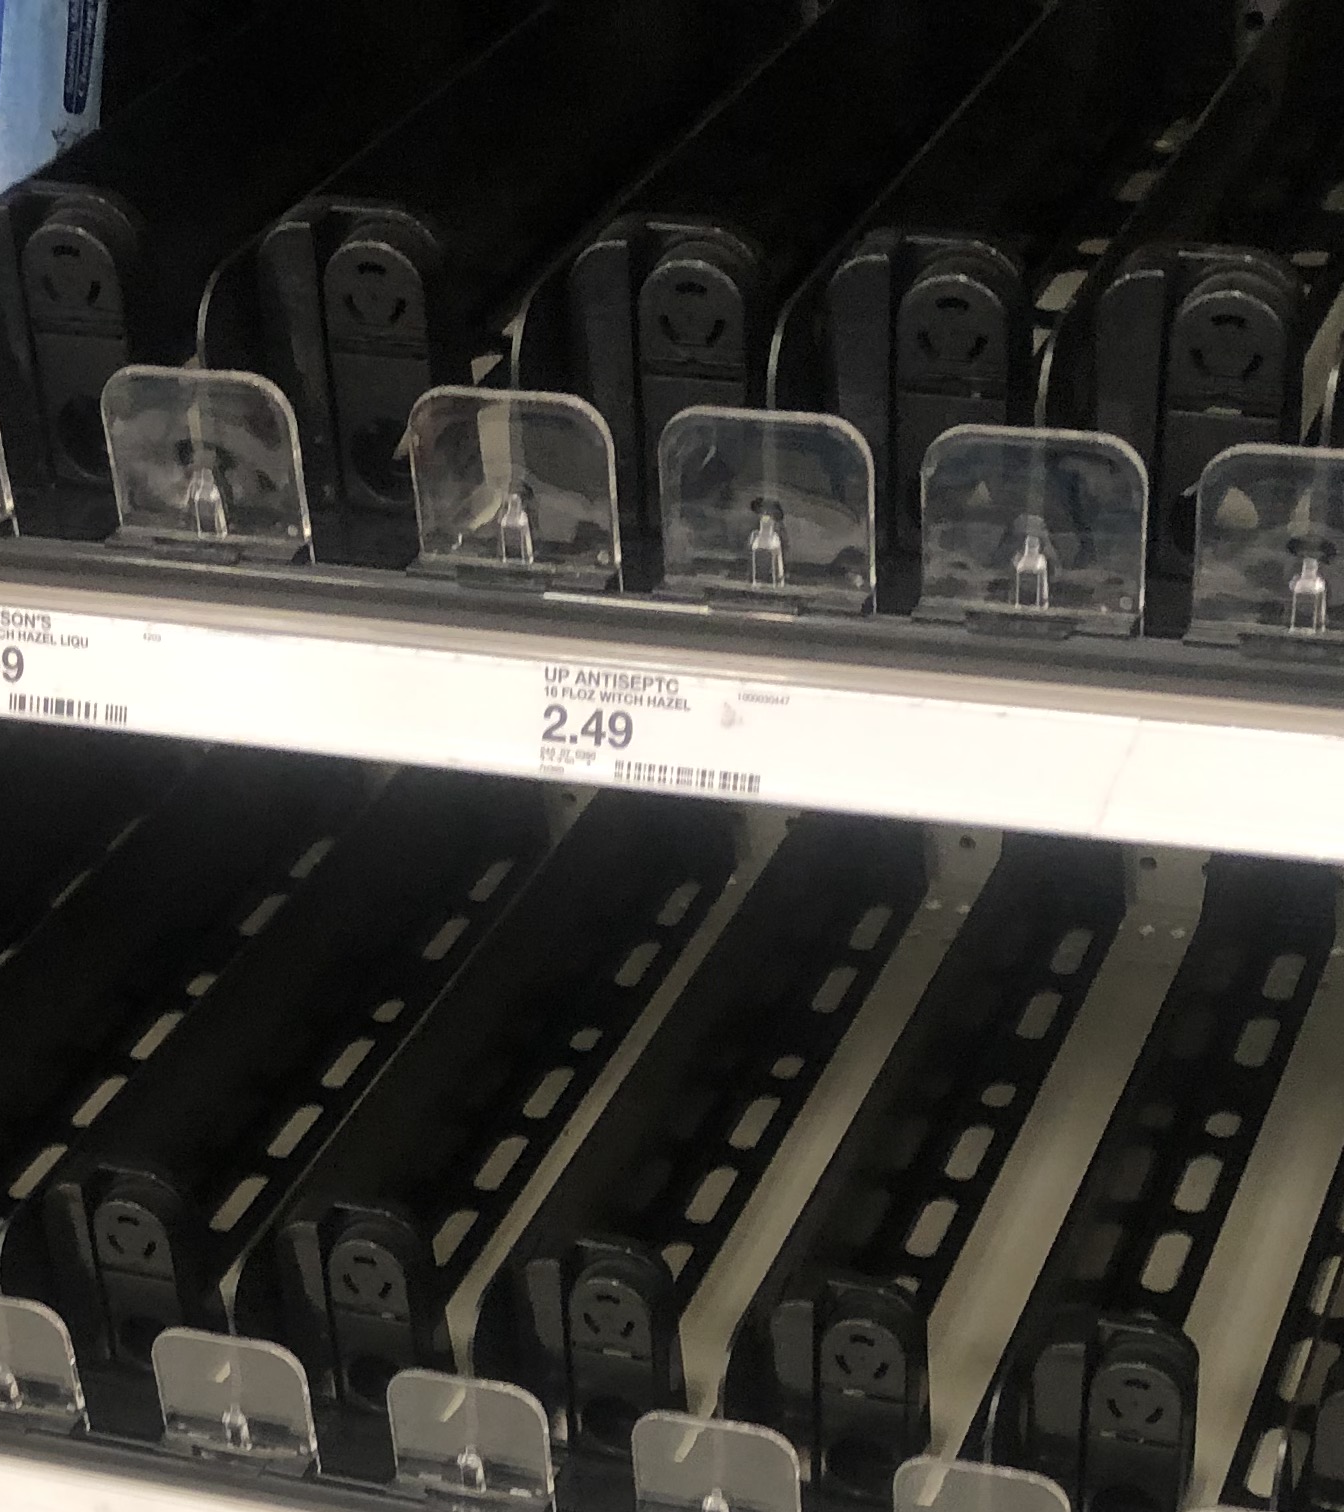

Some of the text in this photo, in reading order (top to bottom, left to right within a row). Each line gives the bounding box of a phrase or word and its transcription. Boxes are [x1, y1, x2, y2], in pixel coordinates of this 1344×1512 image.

[17, 629, 58, 647] HAZEL
[59, 633, 90, 651] LIQU
[544, 665, 571, 685] UP
[561, 687, 596, 703] FLOZ
[599, 689, 644, 707] WITCH
[646, 694, 692, 712] HAZEL
[541, 703, 634, 750] 2.49
